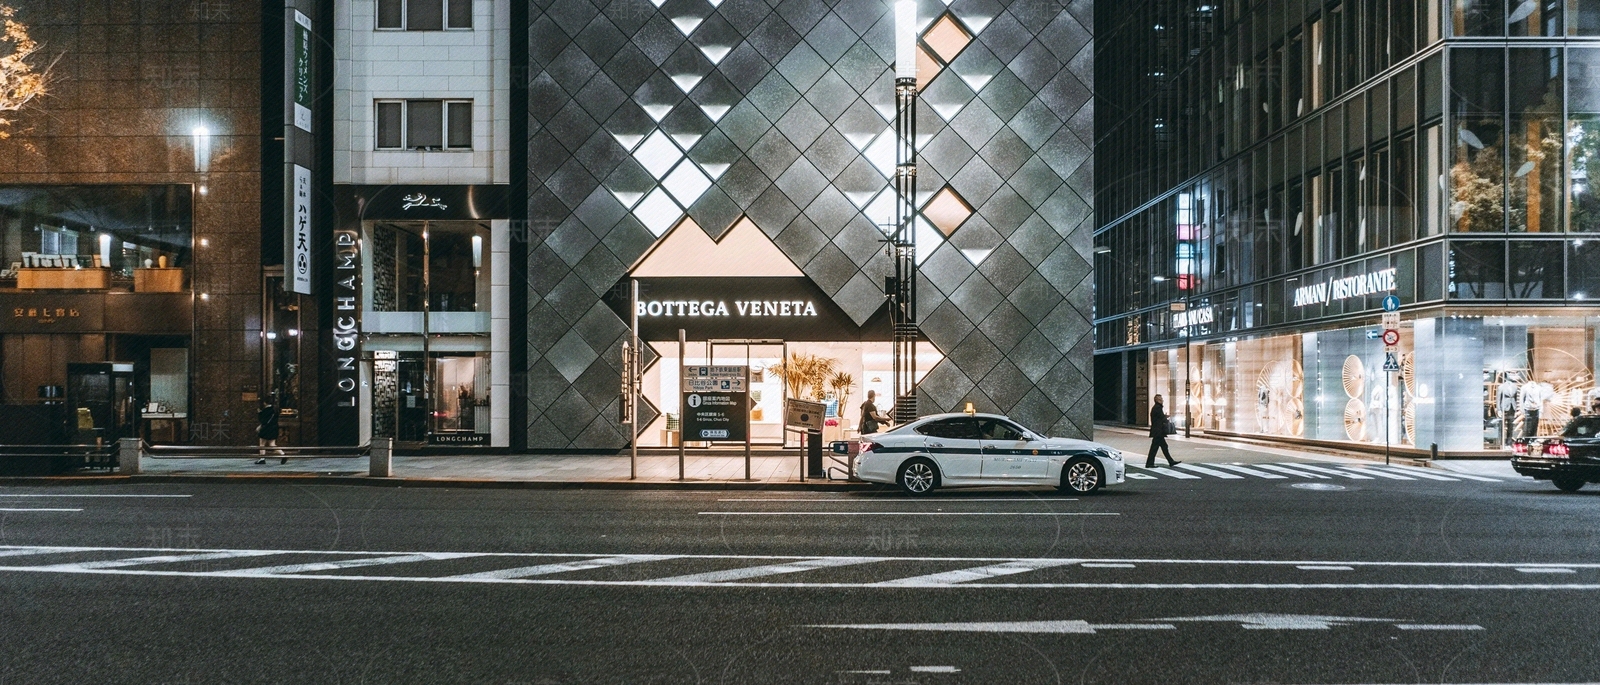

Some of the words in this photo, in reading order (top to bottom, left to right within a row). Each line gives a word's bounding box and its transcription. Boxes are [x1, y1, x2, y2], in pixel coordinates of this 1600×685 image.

[298, 204, 308, 252] ハゲ天
[337, 232, 356, 407] LONGCHAMP
[636, 301, 729, 317] BOTTEGA
[735, 301, 817, 316] VENETA
